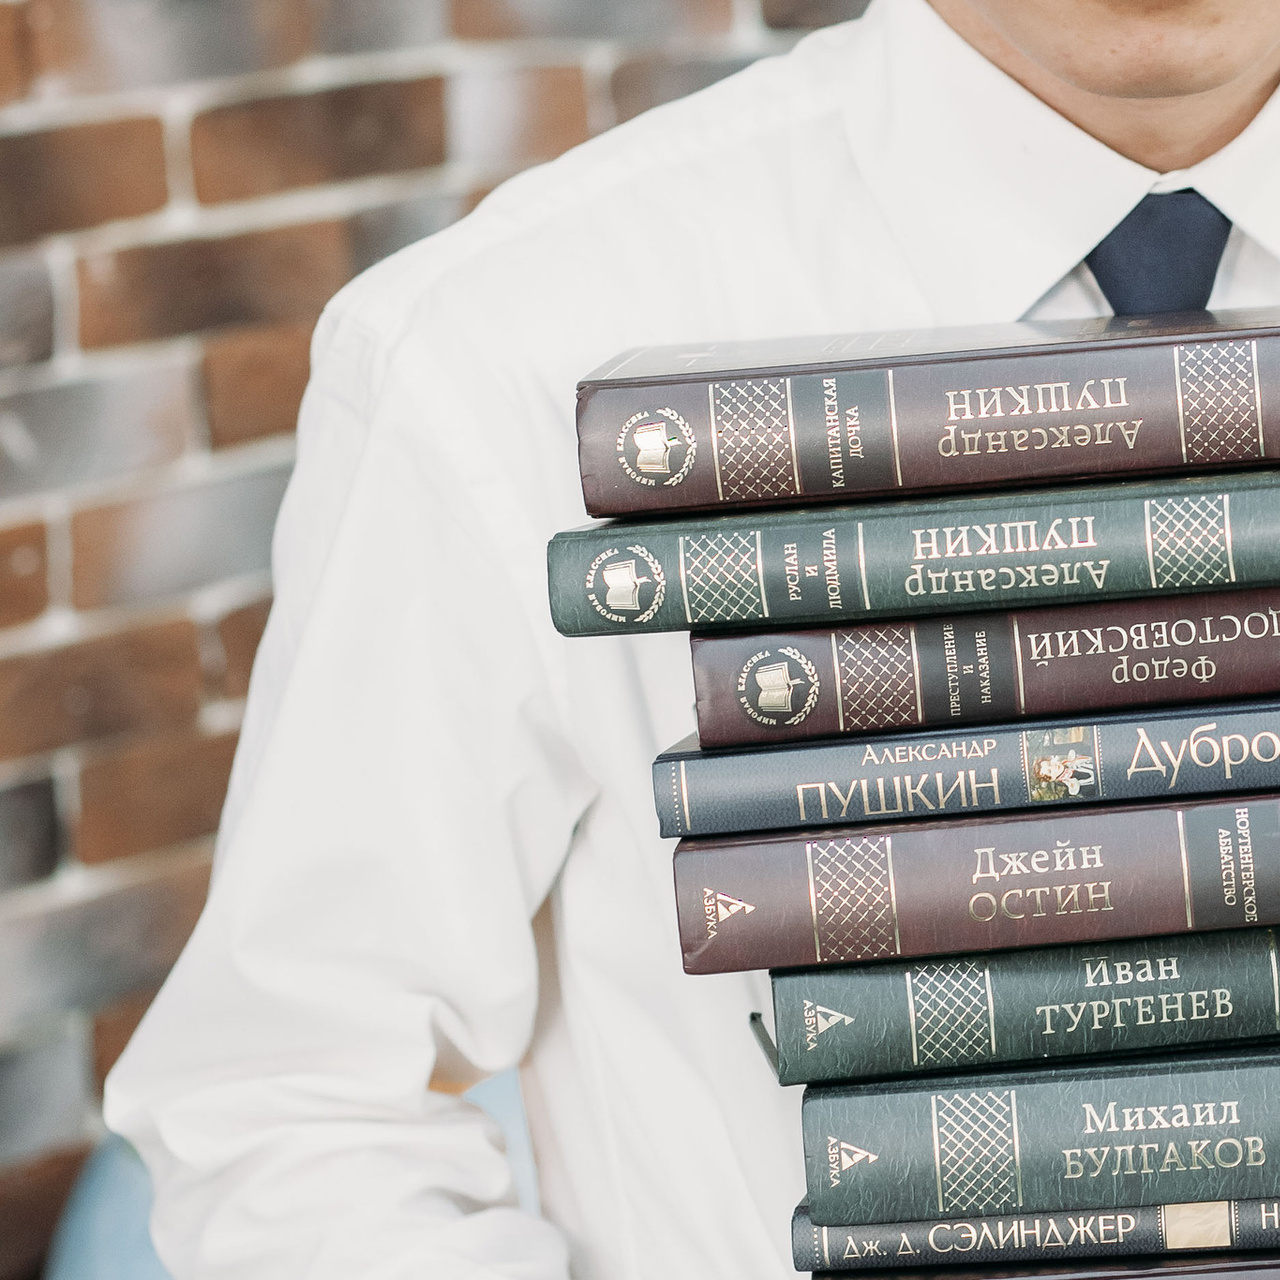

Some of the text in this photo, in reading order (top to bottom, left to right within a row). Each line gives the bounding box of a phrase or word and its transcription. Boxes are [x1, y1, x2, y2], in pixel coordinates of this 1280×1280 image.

[946, 377, 1130, 420] ПУШКИН
[823, 378, 845, 488] КАПИТАНСКАЯ
[846, 406, 864, 458] ДОЧКА
[937, 418, 1144, 457] Александр
[913, 516, 1097, 560] ПУШКИН
[784, 543, 800, 601] РУСЛАН
[805, 564, 818, 577] И
[822, 527, 843, 609] ЛЮДМИЛА
[905, 559, 1111, 596] Александр
[942, 623, 962, 717] ПРЕСТУПЛЕНИЕ
[963, 664, 973, 675] И
[972, 630, 991, 705] НАКАЗАНИЕ
[1112, 656, 1218, 684] Федор
[797, 768, 1000, 820] ПУШКИН
[971, 840, 1104, 883] Джейн
[1218, 828, 1237, 906] АББАТСТВО
[1235, 808, 1258, 923] НОРТЕНГЕРСКОЕ
[703, 887, 717, 940] АЗБУКА
[969, 880, 1114, 921] ОСТИН
[1083, 956, 1181, 988] Иван
[802, 999, 817, 1051] АЗБУКА
[1036, 988, 1234, 1035] ТУРГЕНЕВ
[1082, 1101, 1240, 1135] Михаил
[827, 1136, 841, 1188] АЗБУКА
[1063, 1136, 1267, 1180] БУЛГАКОВ
[897, 1232, 921, 1256] Д.
[928, 1214, 1136, 1252] СЭЛИНДЖЕР
